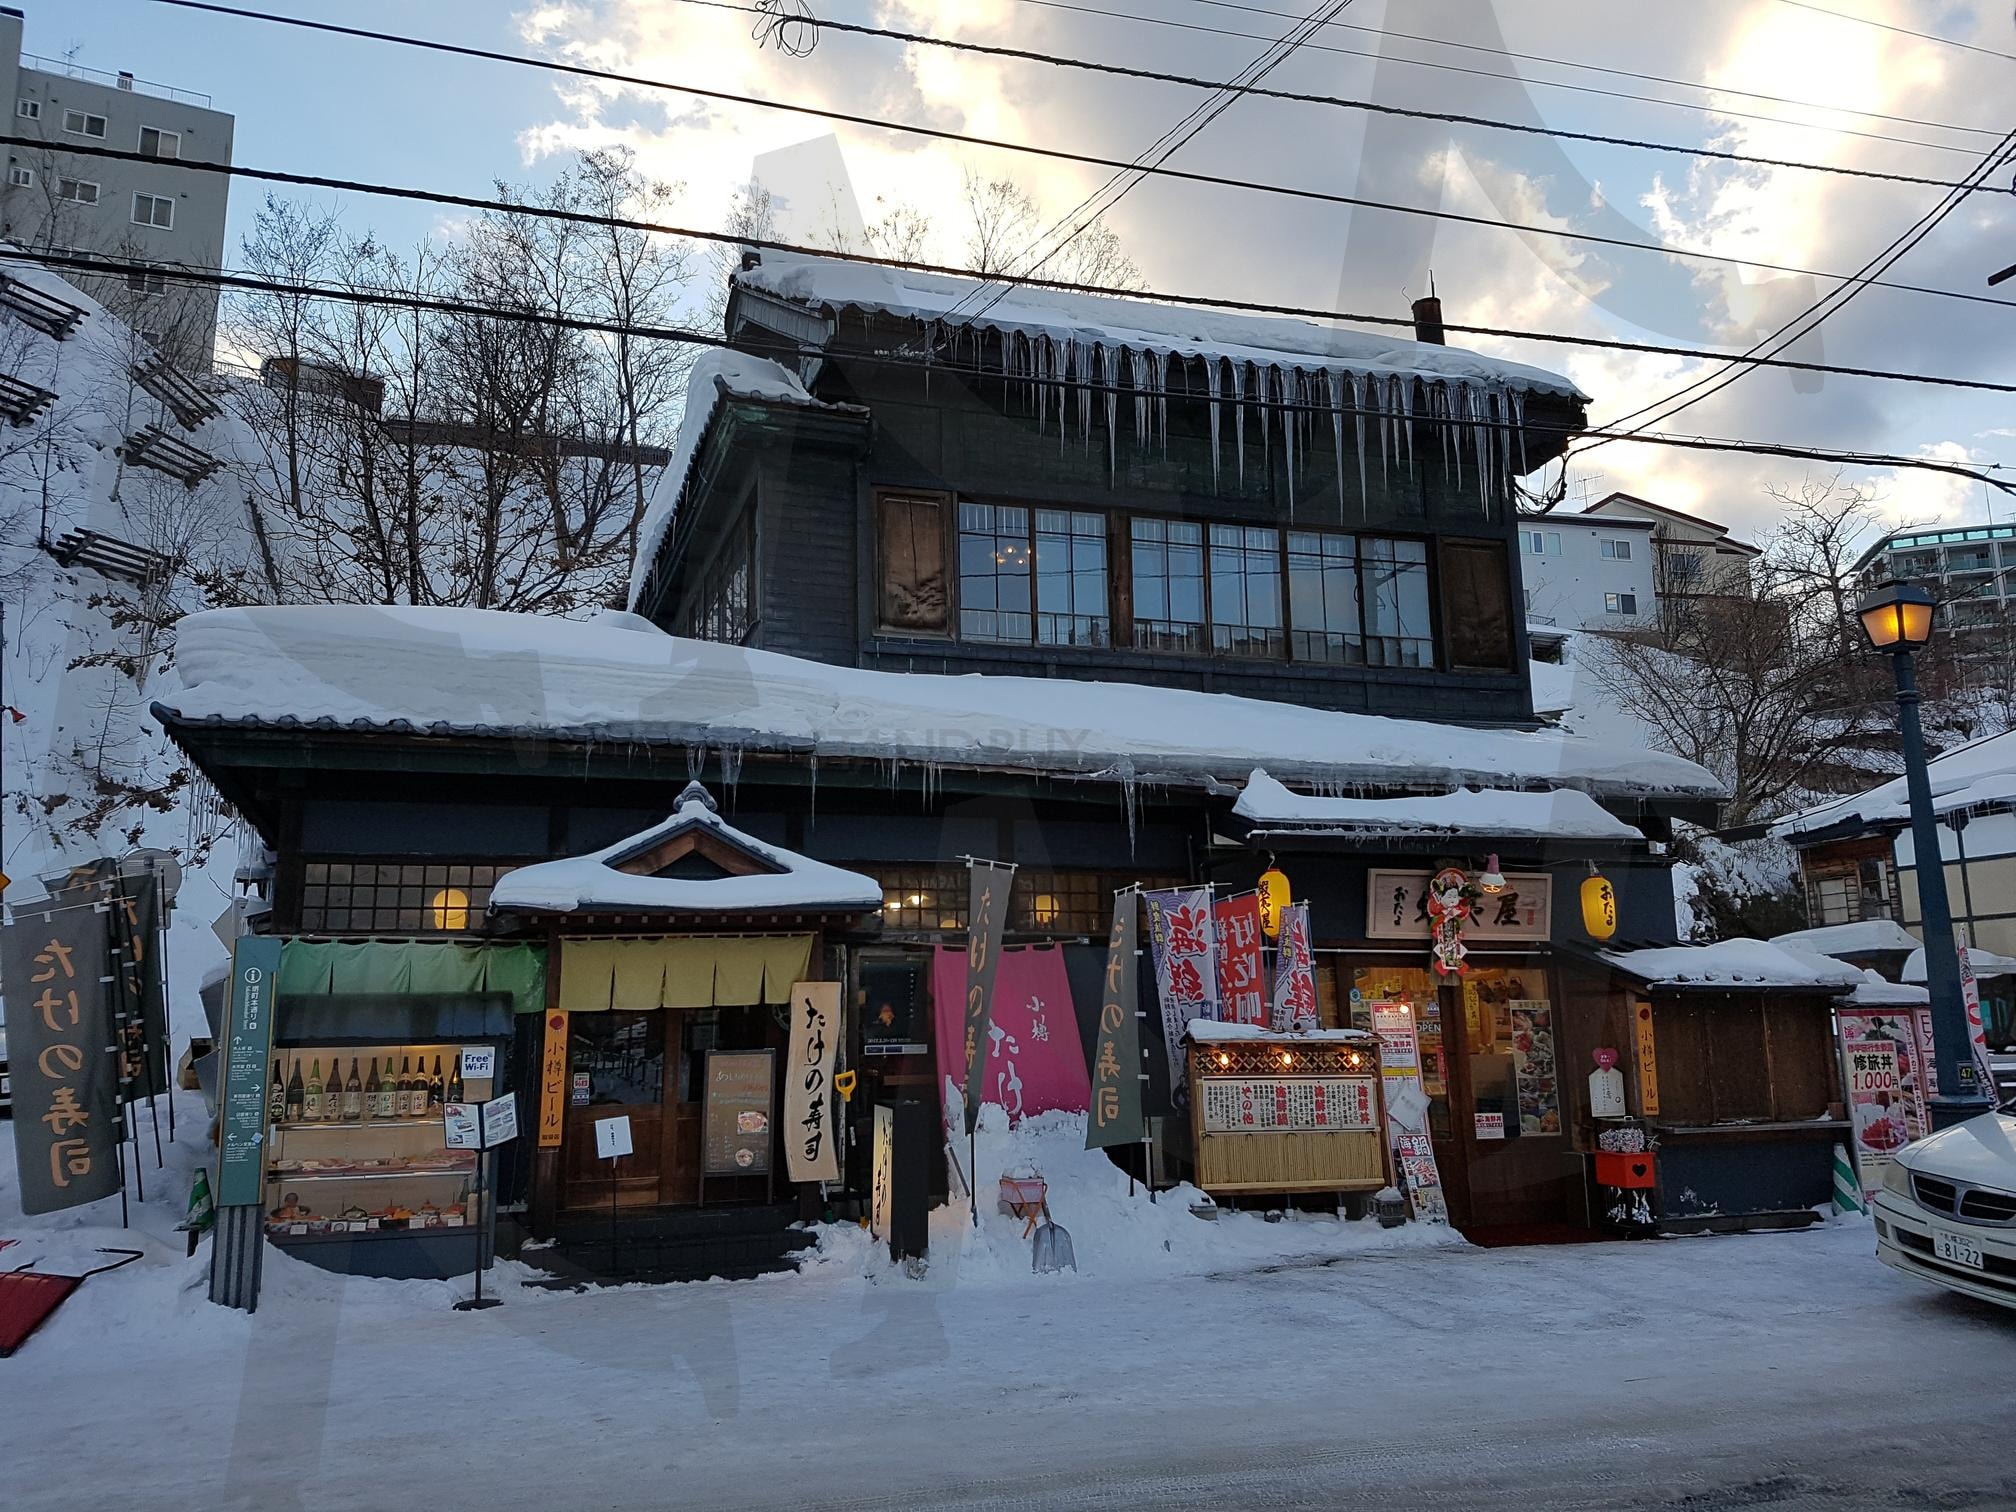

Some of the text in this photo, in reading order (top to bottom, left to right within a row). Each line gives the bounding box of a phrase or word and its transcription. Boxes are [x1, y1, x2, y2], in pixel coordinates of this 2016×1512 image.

[1600, 884, 1613, 926] おたる
[465, 1054, 489, 1063] Free
[465, 1062, 489, 1071] Wi-Fi
[1641, 1030, 1656, 1100] 小樽ビール
[1853, 1054, 1893, 1071] 修旅丼
[1960, 1067, 1972, 1078] 47
[546, 1041, 565, 1127] 小樽ビール
[801, 997, 826, 1162] たけの寿司
[1241, 1086, 1254, 1126] その他
[1944, 1242, 1981, 1267] 81-22
